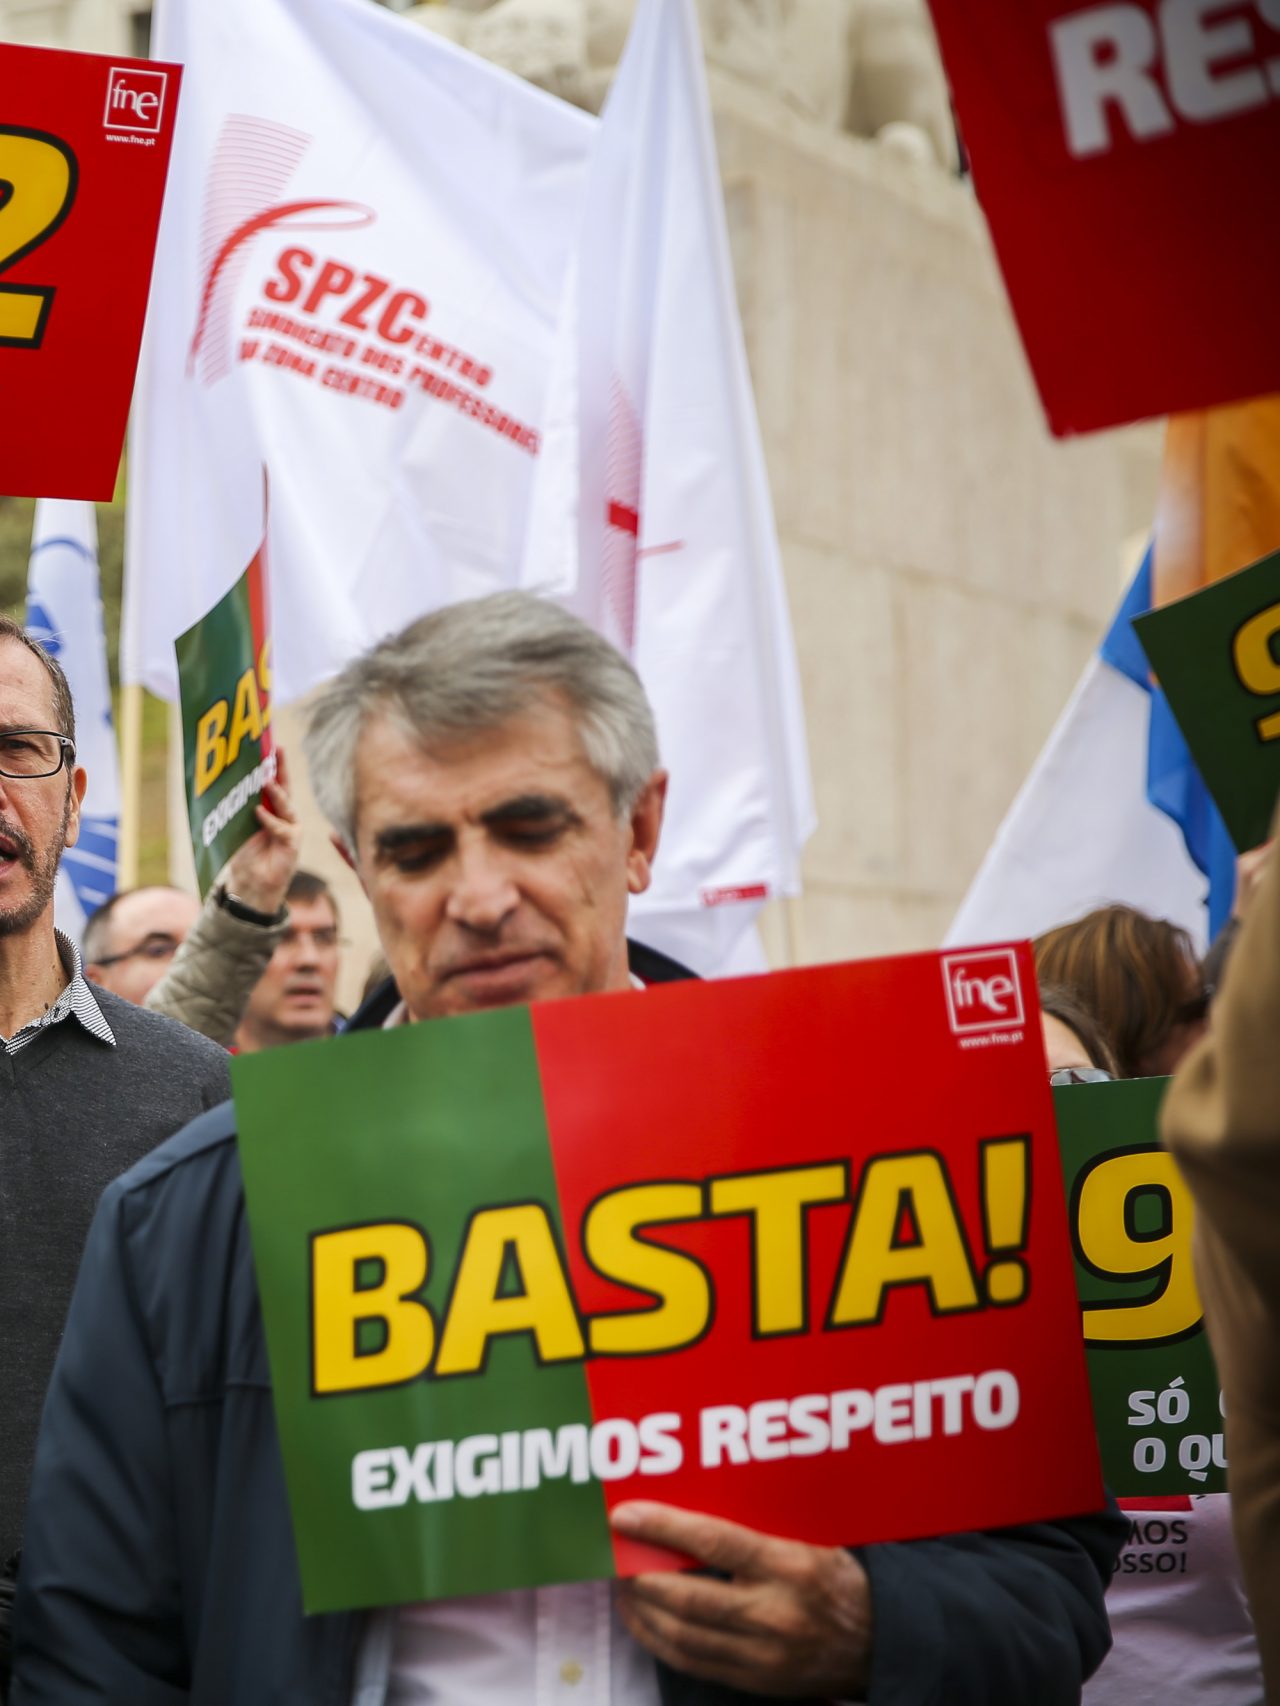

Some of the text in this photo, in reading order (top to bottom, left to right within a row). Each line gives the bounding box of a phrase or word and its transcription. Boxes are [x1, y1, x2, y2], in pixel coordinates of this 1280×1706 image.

[113, 79, 159, 120] fne
[105, 134, 156, 147] www.fne.pt
[953, 967, 1015, 1013] fne
[309, 1133, 1032, 1399] BASTA!
[1128, 1376, 1190, 1426] SÓ
[352, 1370, 1020, 1511] EXIGIMOS RESPEITO
[1133, 1437, 1166, 1473] O
[1113, 1552, 1187, 1574] SSO!
